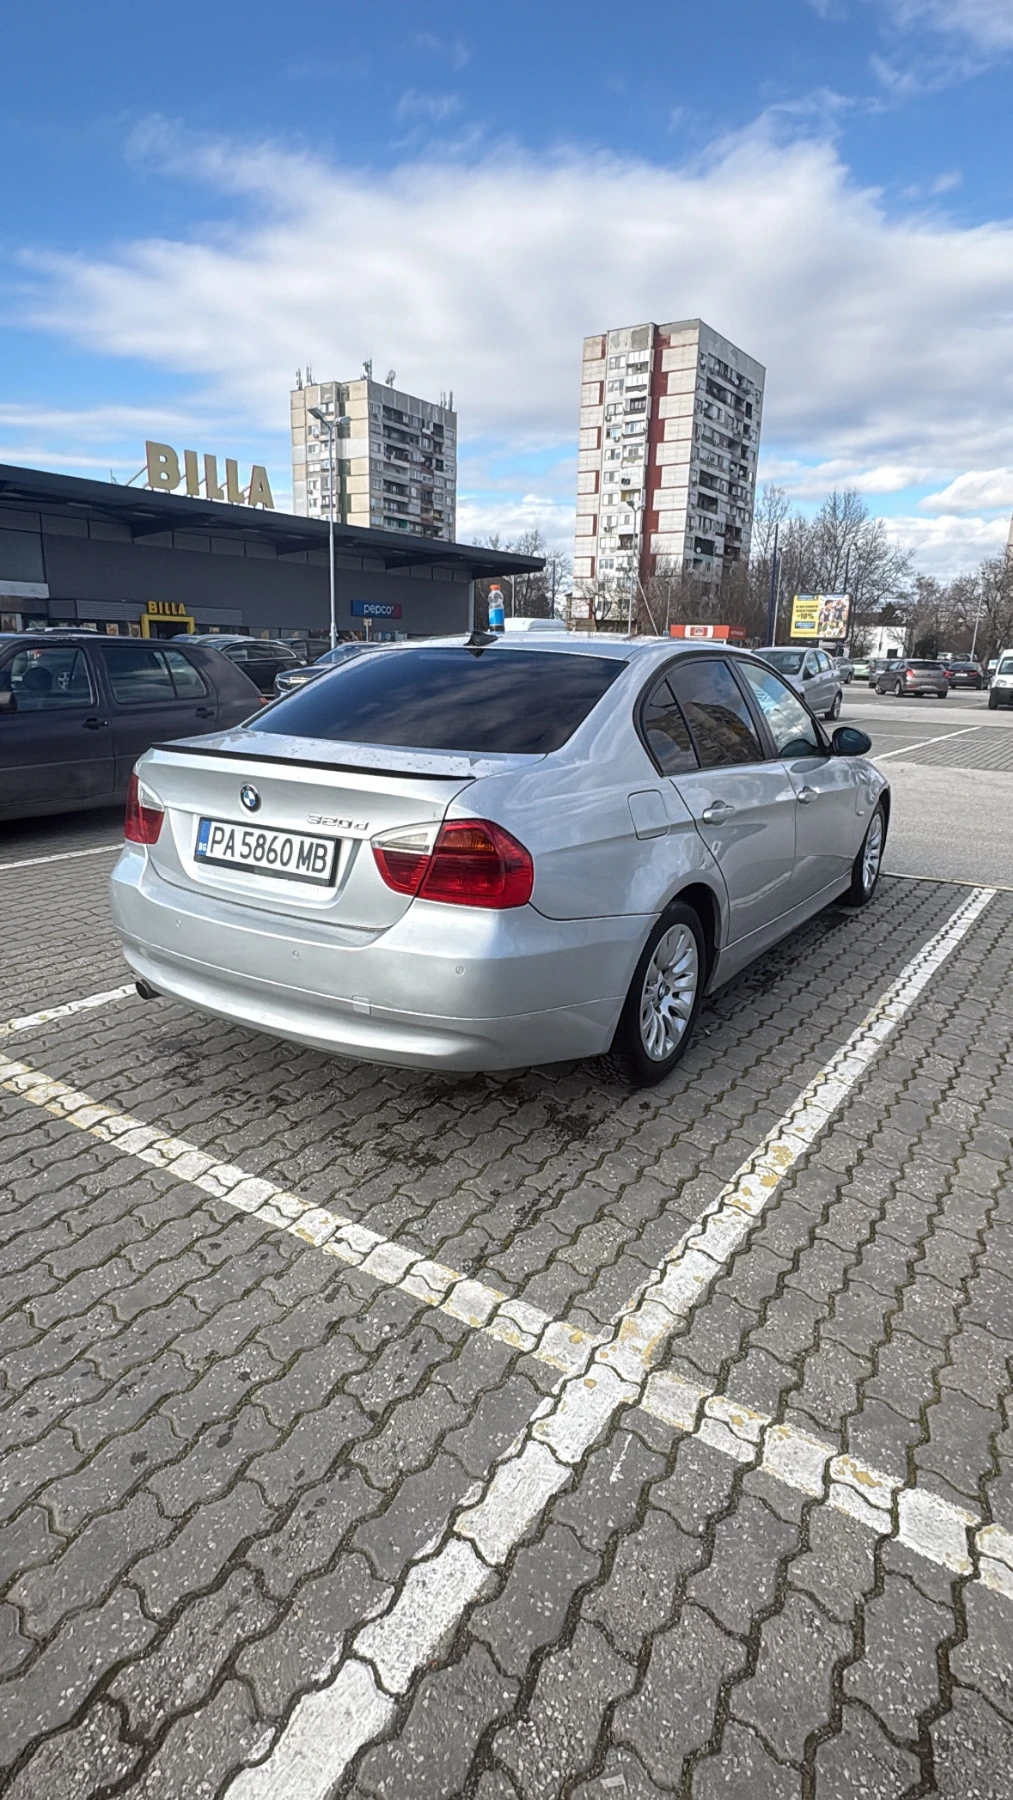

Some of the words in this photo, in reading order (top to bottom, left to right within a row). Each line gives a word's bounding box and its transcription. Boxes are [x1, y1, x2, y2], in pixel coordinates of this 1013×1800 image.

[145, 440, 275, 510] BILLA
[147, 600, 187, 616] BILLA
[363, 604, 392, 615] pepco
[306, 814, 370, 831] 320d
[198, 842, 207, 852] BG
[210, 826, 235, 858] PA
[239, 831, 294, 867] 5860
[295, 840, 328, 874] MB
